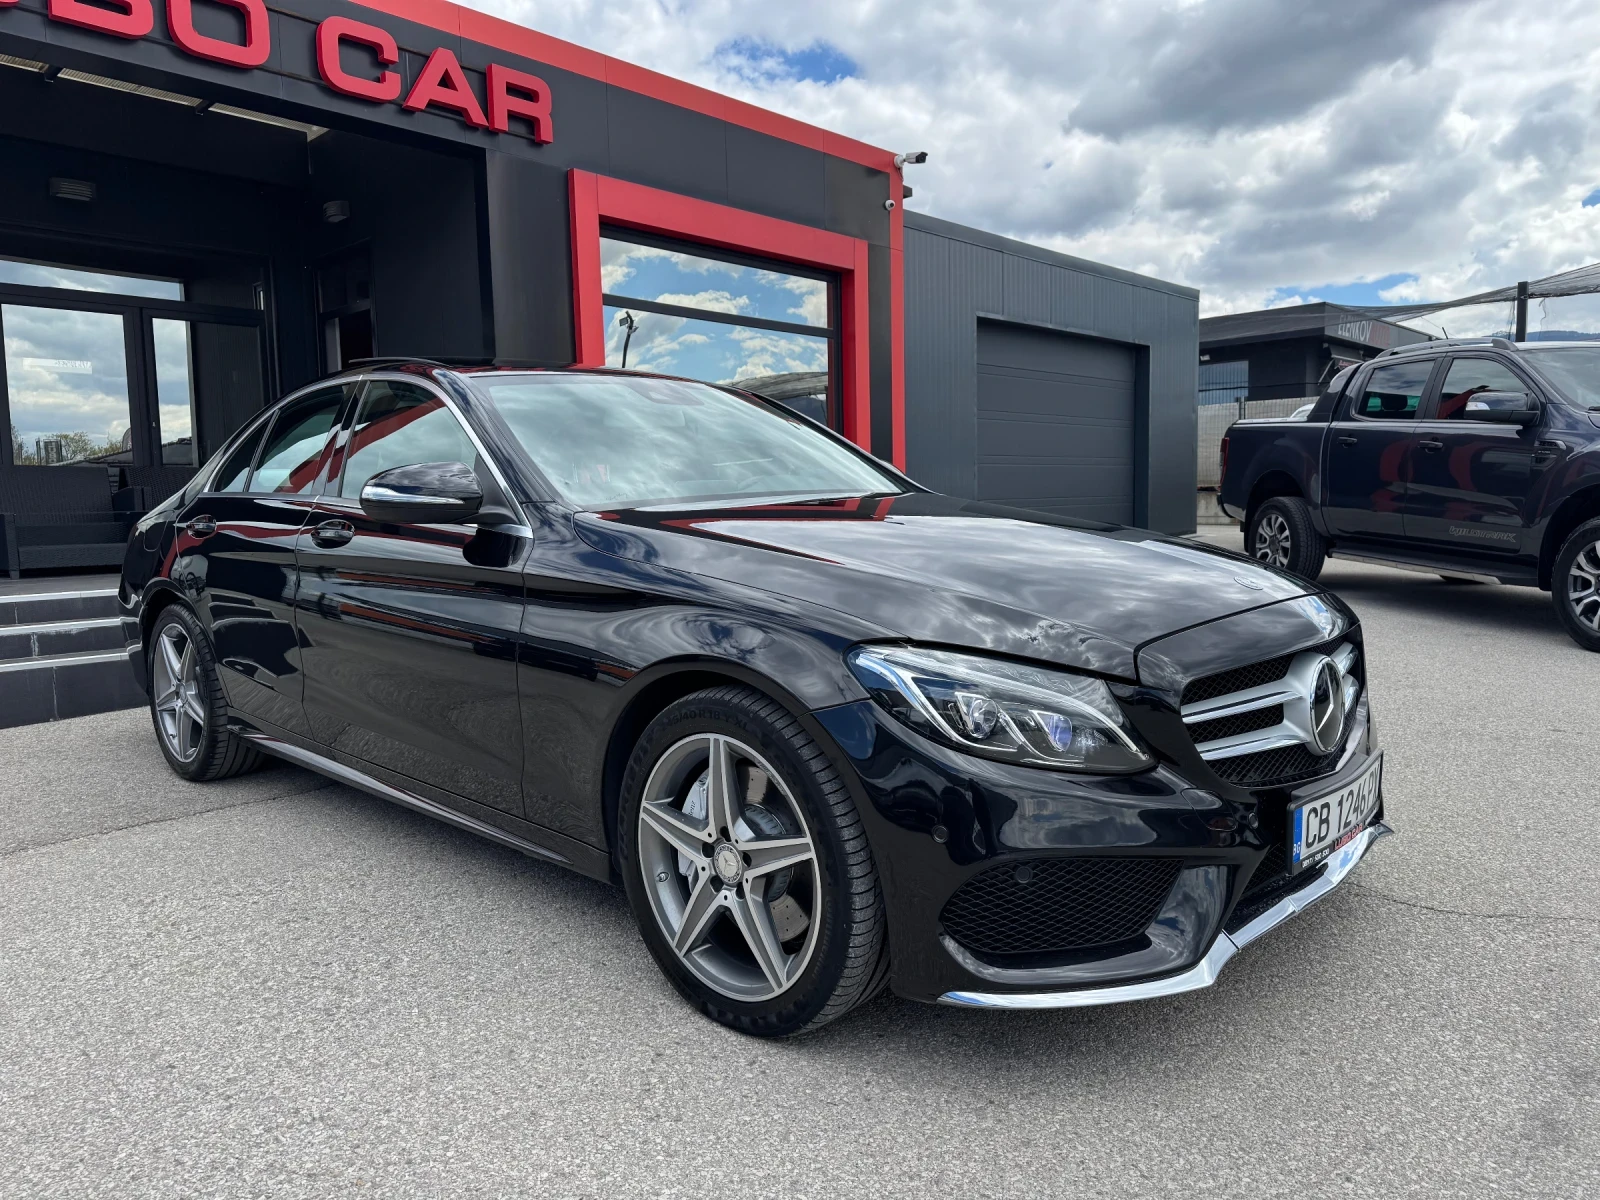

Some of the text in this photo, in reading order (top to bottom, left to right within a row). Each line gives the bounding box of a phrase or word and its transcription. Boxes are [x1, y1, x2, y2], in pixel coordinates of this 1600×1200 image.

[316, 15, 554, 145] CAR
[1306, 802, 1330, 848] CB
[1337, 778, 1367, 834] 1246
